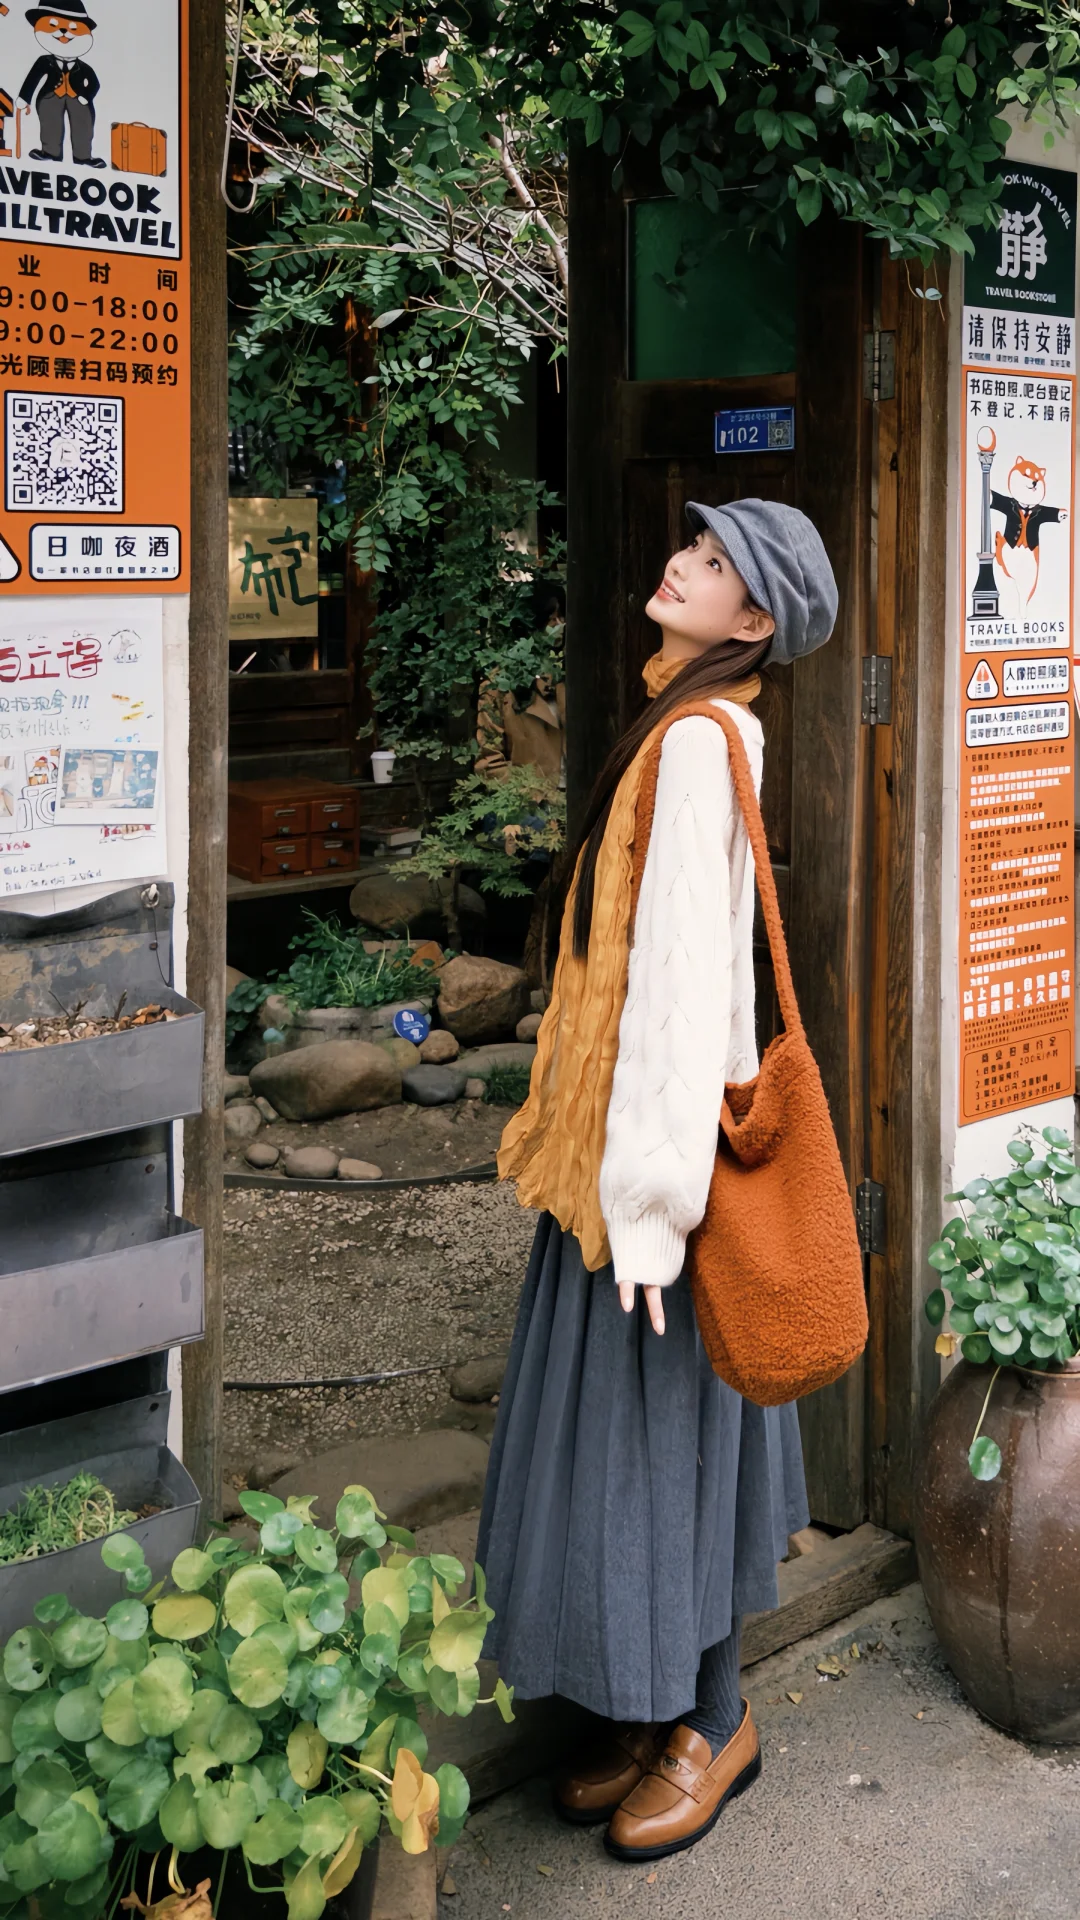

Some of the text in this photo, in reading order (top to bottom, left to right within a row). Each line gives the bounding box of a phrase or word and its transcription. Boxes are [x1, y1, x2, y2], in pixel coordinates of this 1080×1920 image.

[985, 286, 1013, 298] TRAVEL
[968, 313, 1071, 356] 请保持安静
[0, 353, 178, 387] 光顾需扫码预约
[48, 535, 170, 558] 日咖夜酒
[970, 621, 1065, 636] TRAVEL BOOKS
